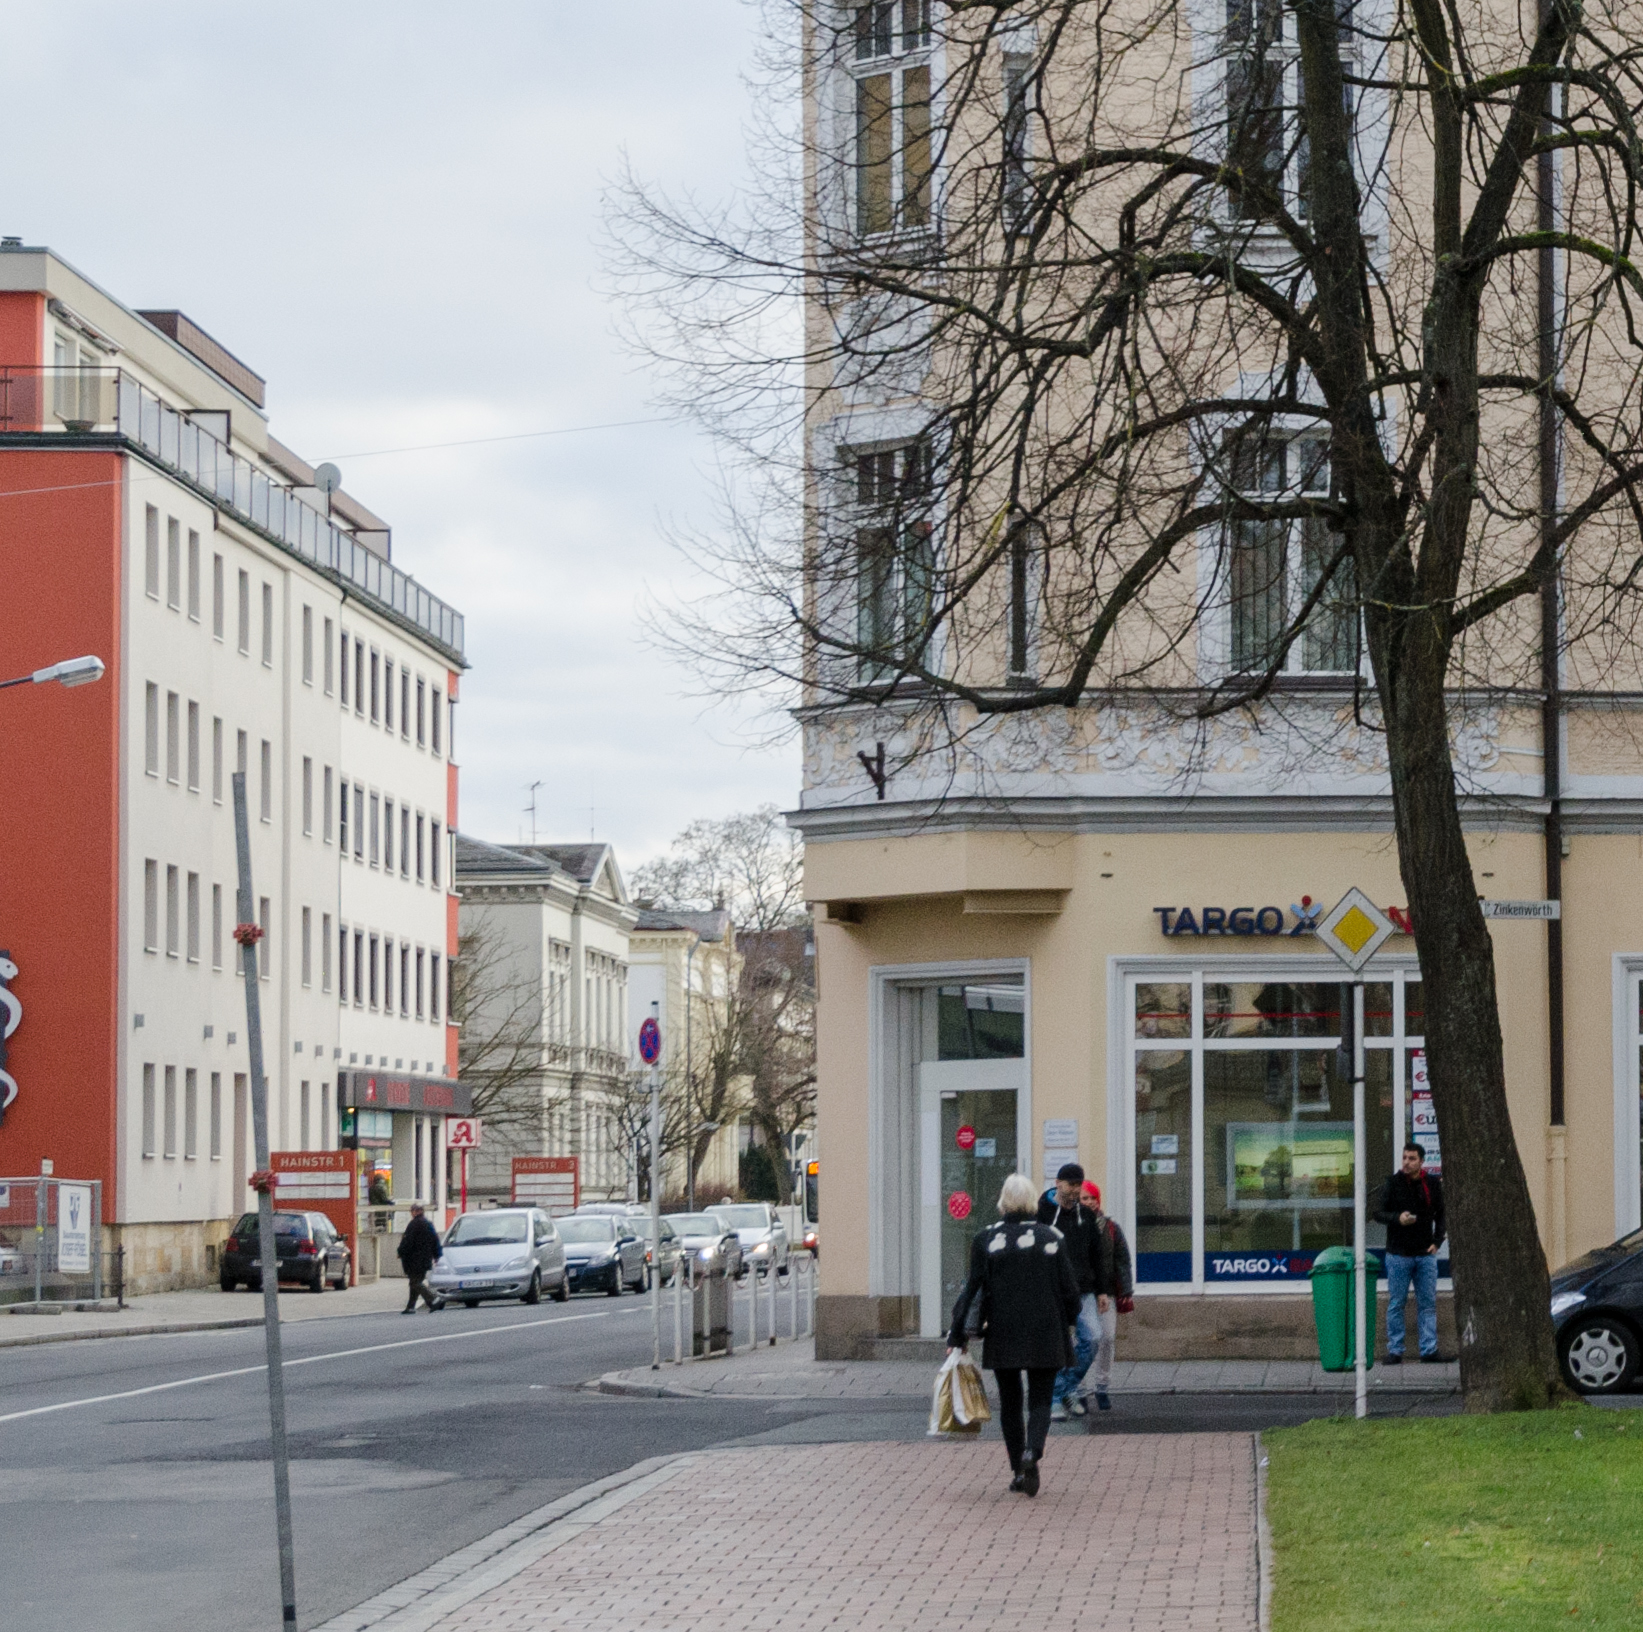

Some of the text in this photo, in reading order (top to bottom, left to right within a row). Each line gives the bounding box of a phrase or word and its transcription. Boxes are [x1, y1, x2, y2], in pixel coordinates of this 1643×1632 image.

[1493, 903, 1553, 916] Zinkenwörth
[1153, 907, 1285, 936] TARGO
[1212, 1259, 1270, 1274] TARGO
